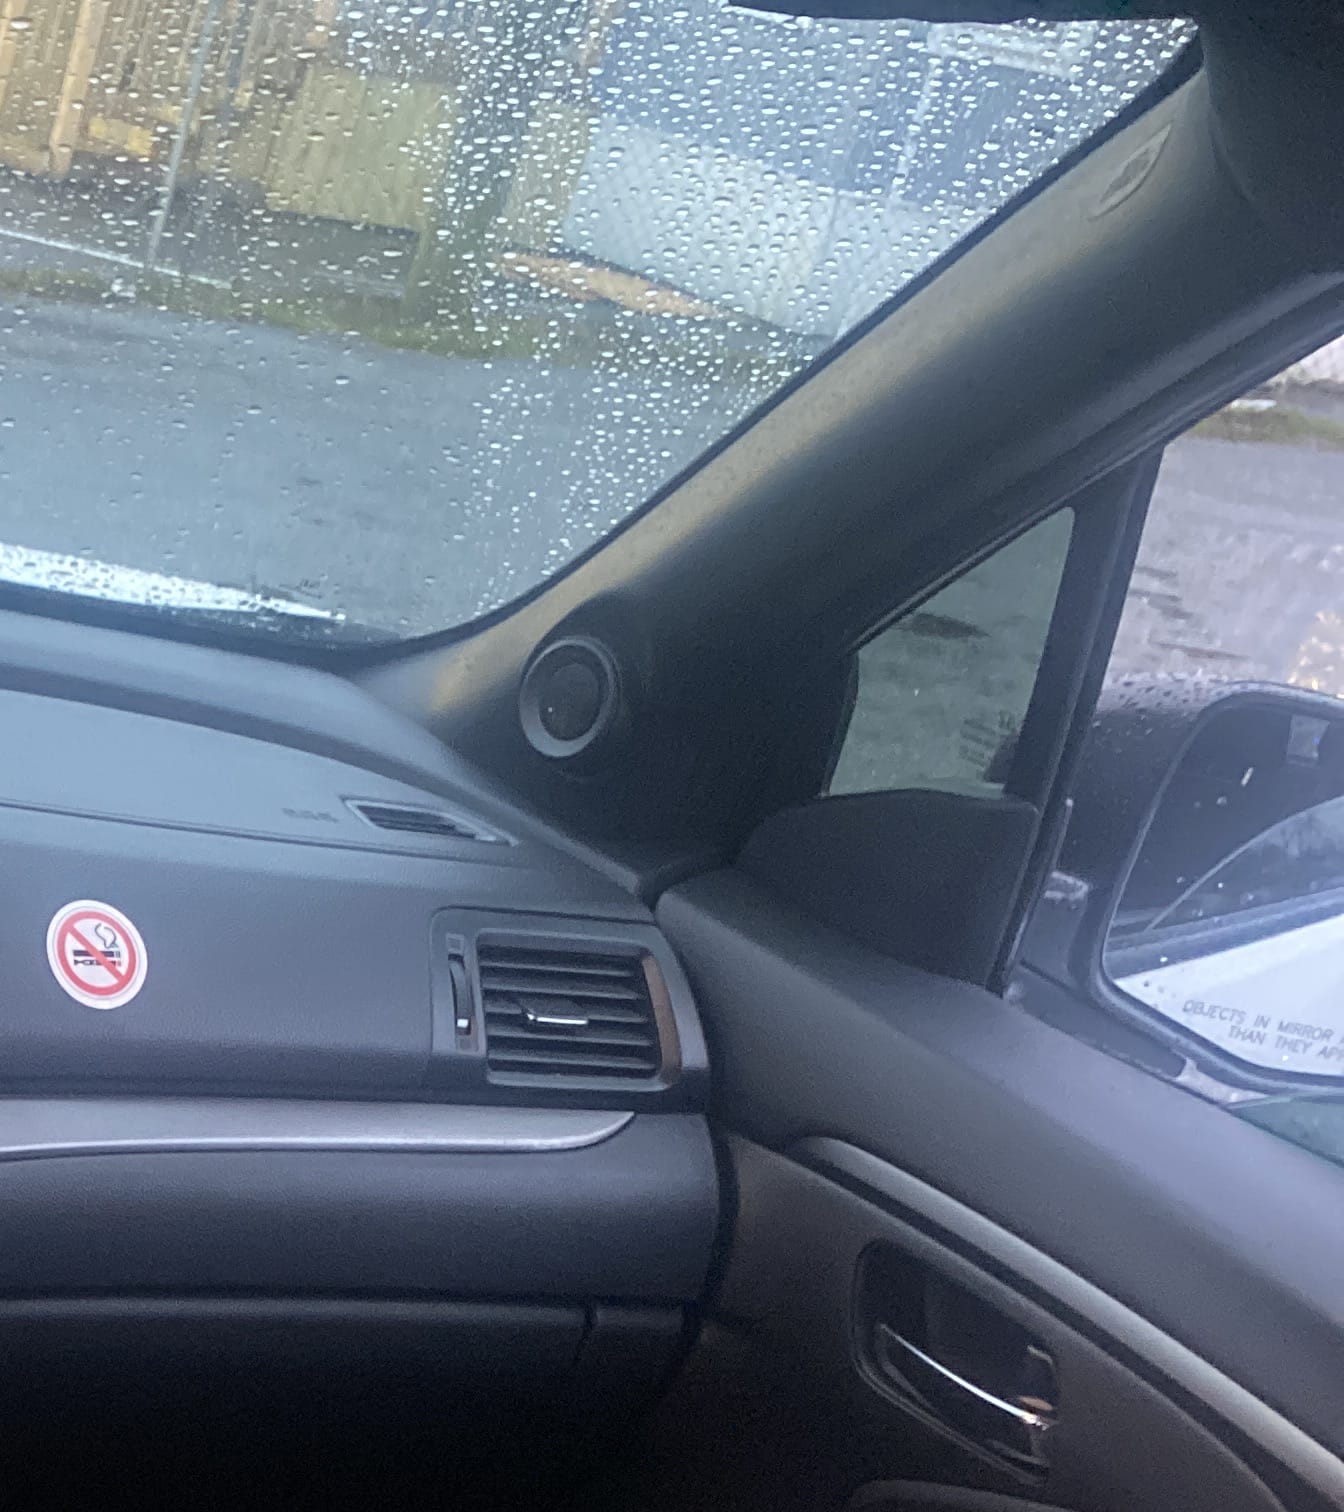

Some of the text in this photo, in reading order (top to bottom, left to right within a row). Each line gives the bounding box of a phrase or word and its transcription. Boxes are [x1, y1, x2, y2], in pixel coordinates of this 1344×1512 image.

[1182, 1000, 1246, 1025] OBJECTS
[1253, 1015, 1271, 1029] IN
[1277, 1021, 1335, 1041] MIRROR
[1229, 1025, 1266, 1045] THAN
[1275, 1035, 1313, 1054] THEY
